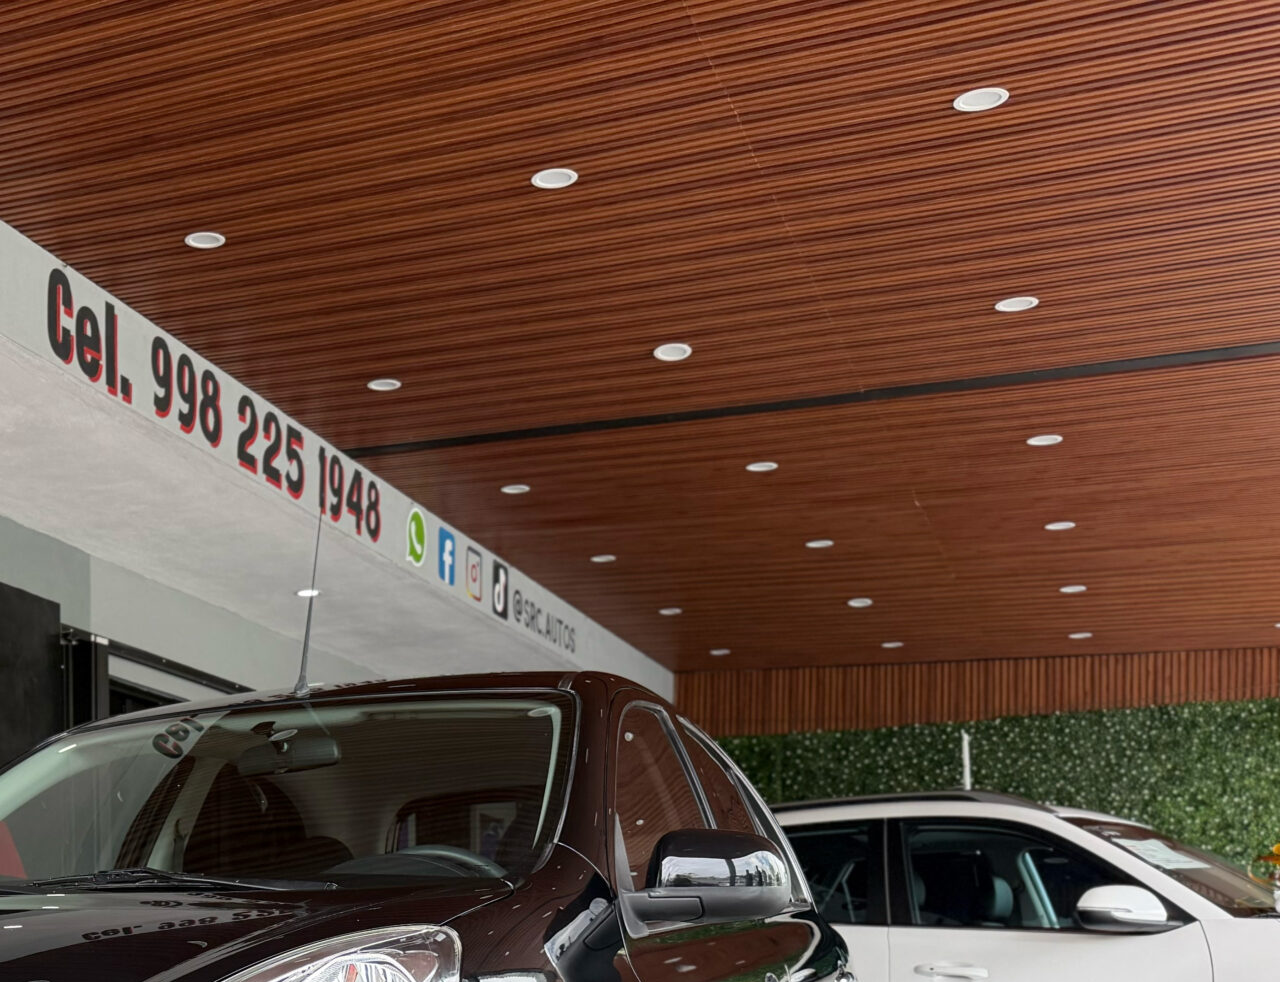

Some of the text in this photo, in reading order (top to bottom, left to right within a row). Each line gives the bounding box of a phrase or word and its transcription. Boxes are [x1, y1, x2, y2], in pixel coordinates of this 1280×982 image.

[47, 268, 382, 543] Cel. 998 225 1948
[513, 589, 576, 654] @SRC.AUTOS
